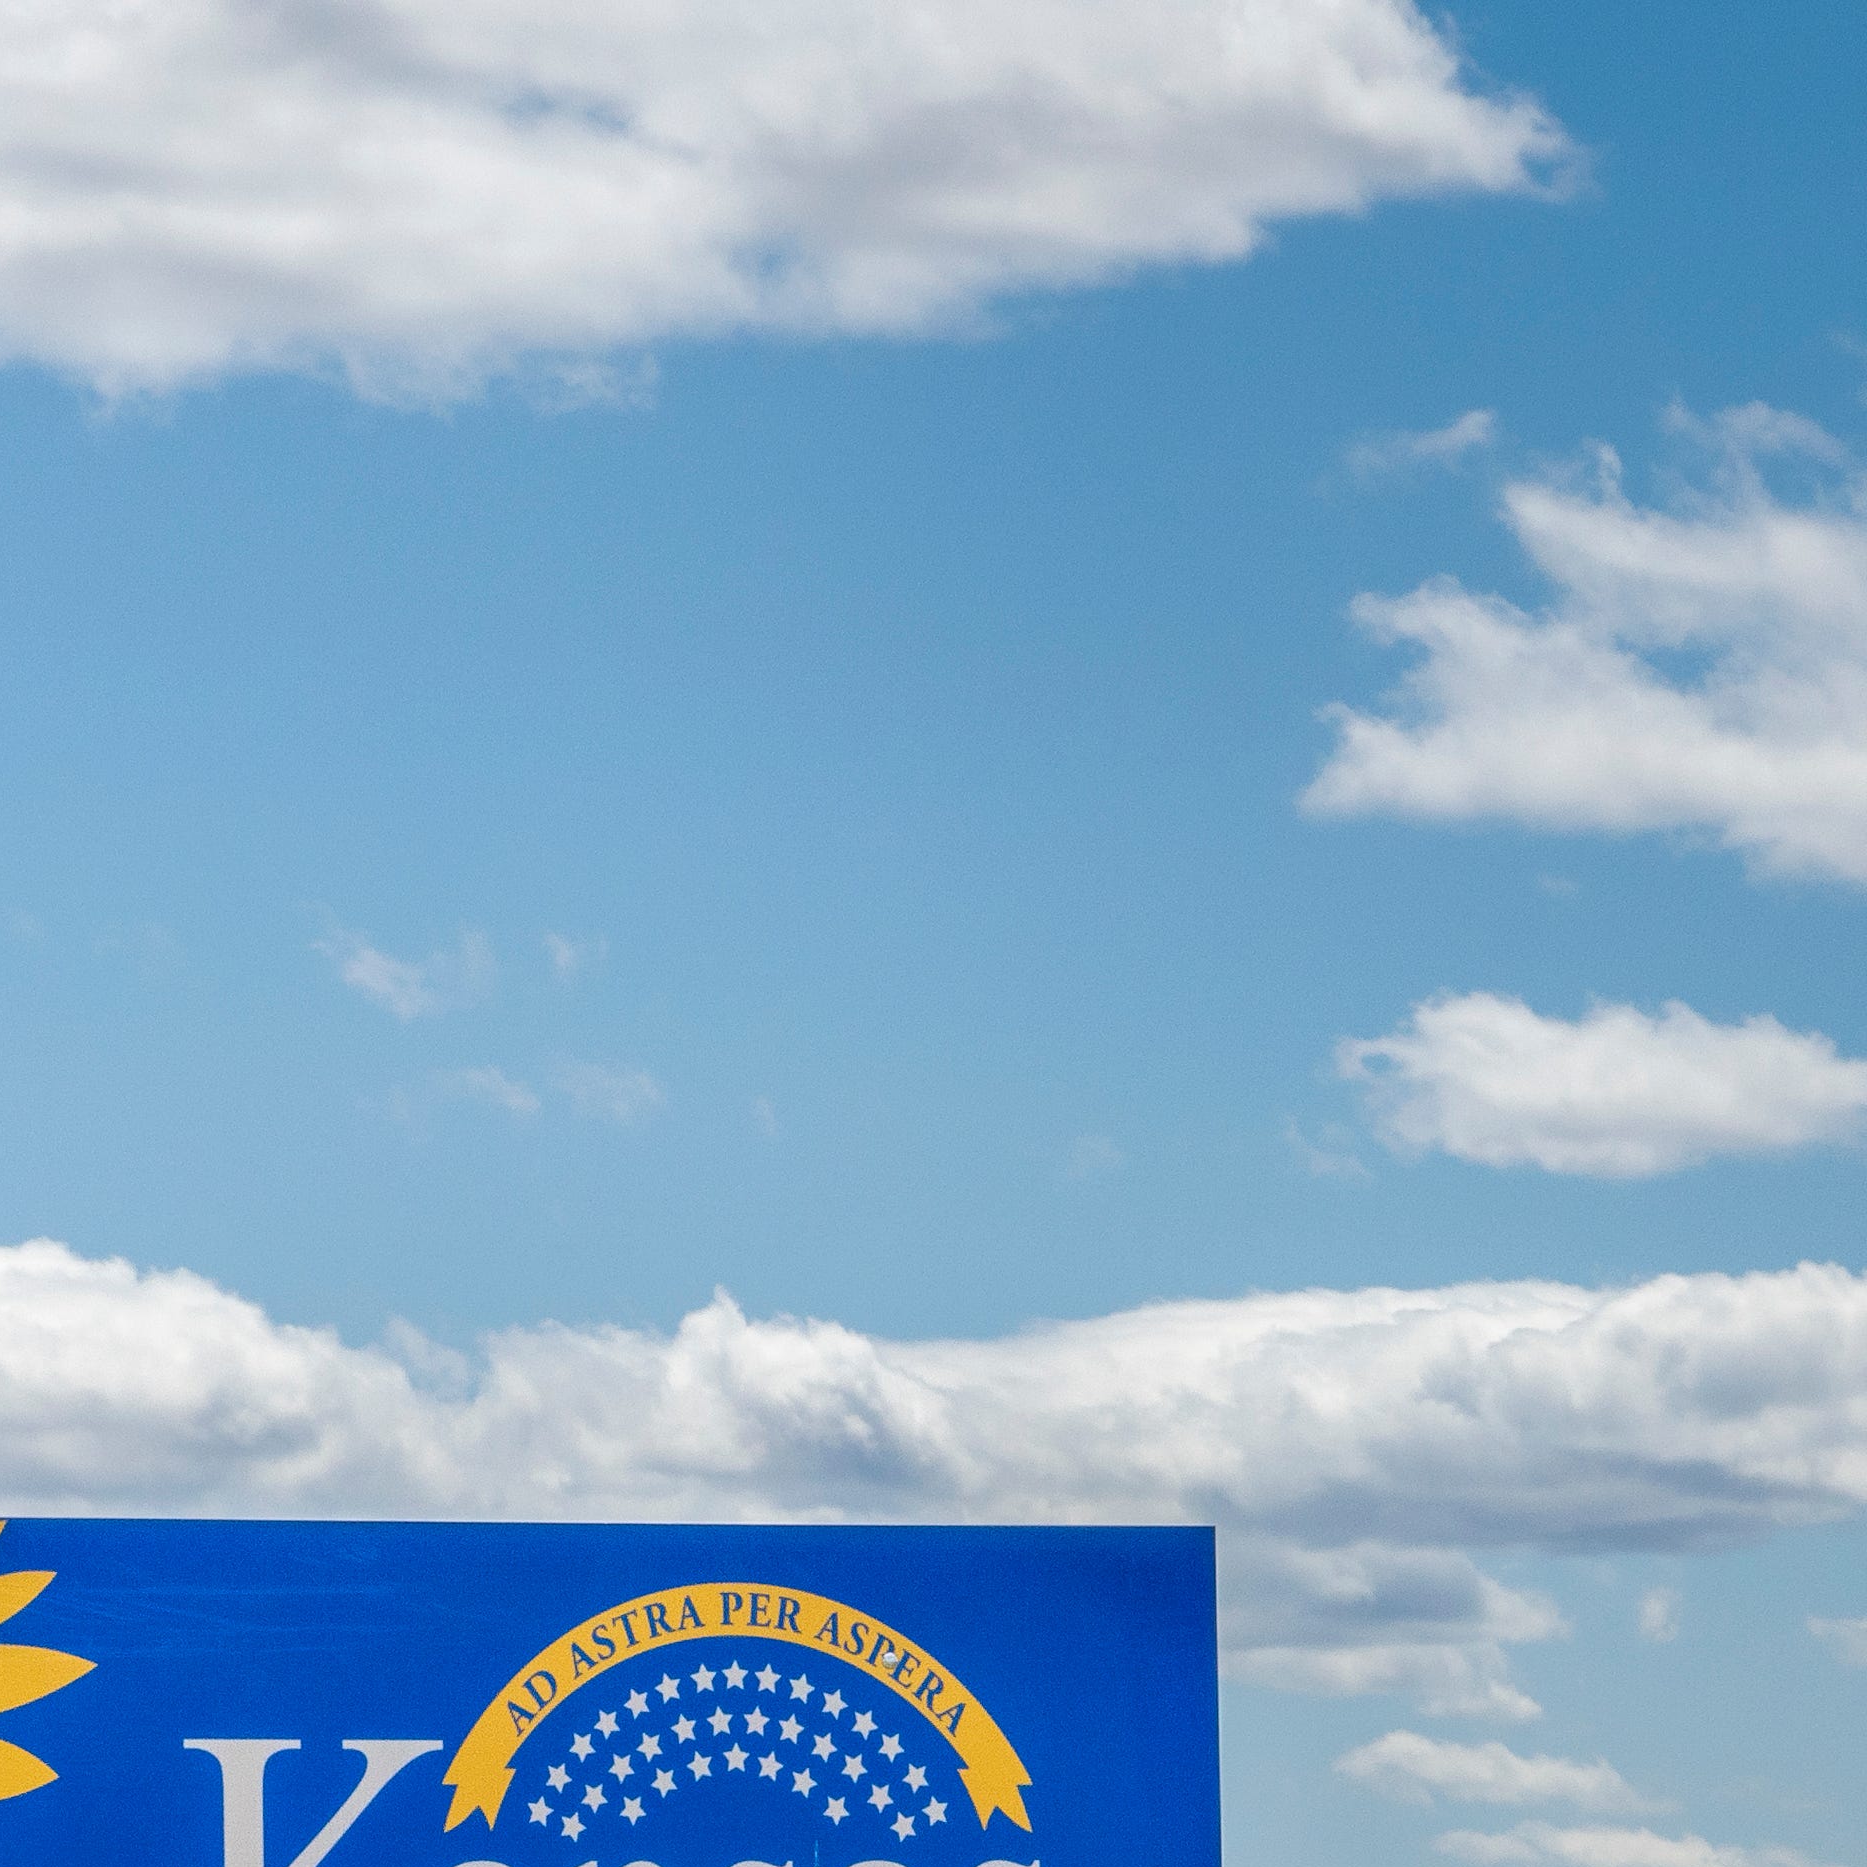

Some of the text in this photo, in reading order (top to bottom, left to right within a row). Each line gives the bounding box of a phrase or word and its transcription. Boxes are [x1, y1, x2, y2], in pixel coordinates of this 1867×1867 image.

[505, 1590, 969, 1739] AD ASTRA PER ASPERA
